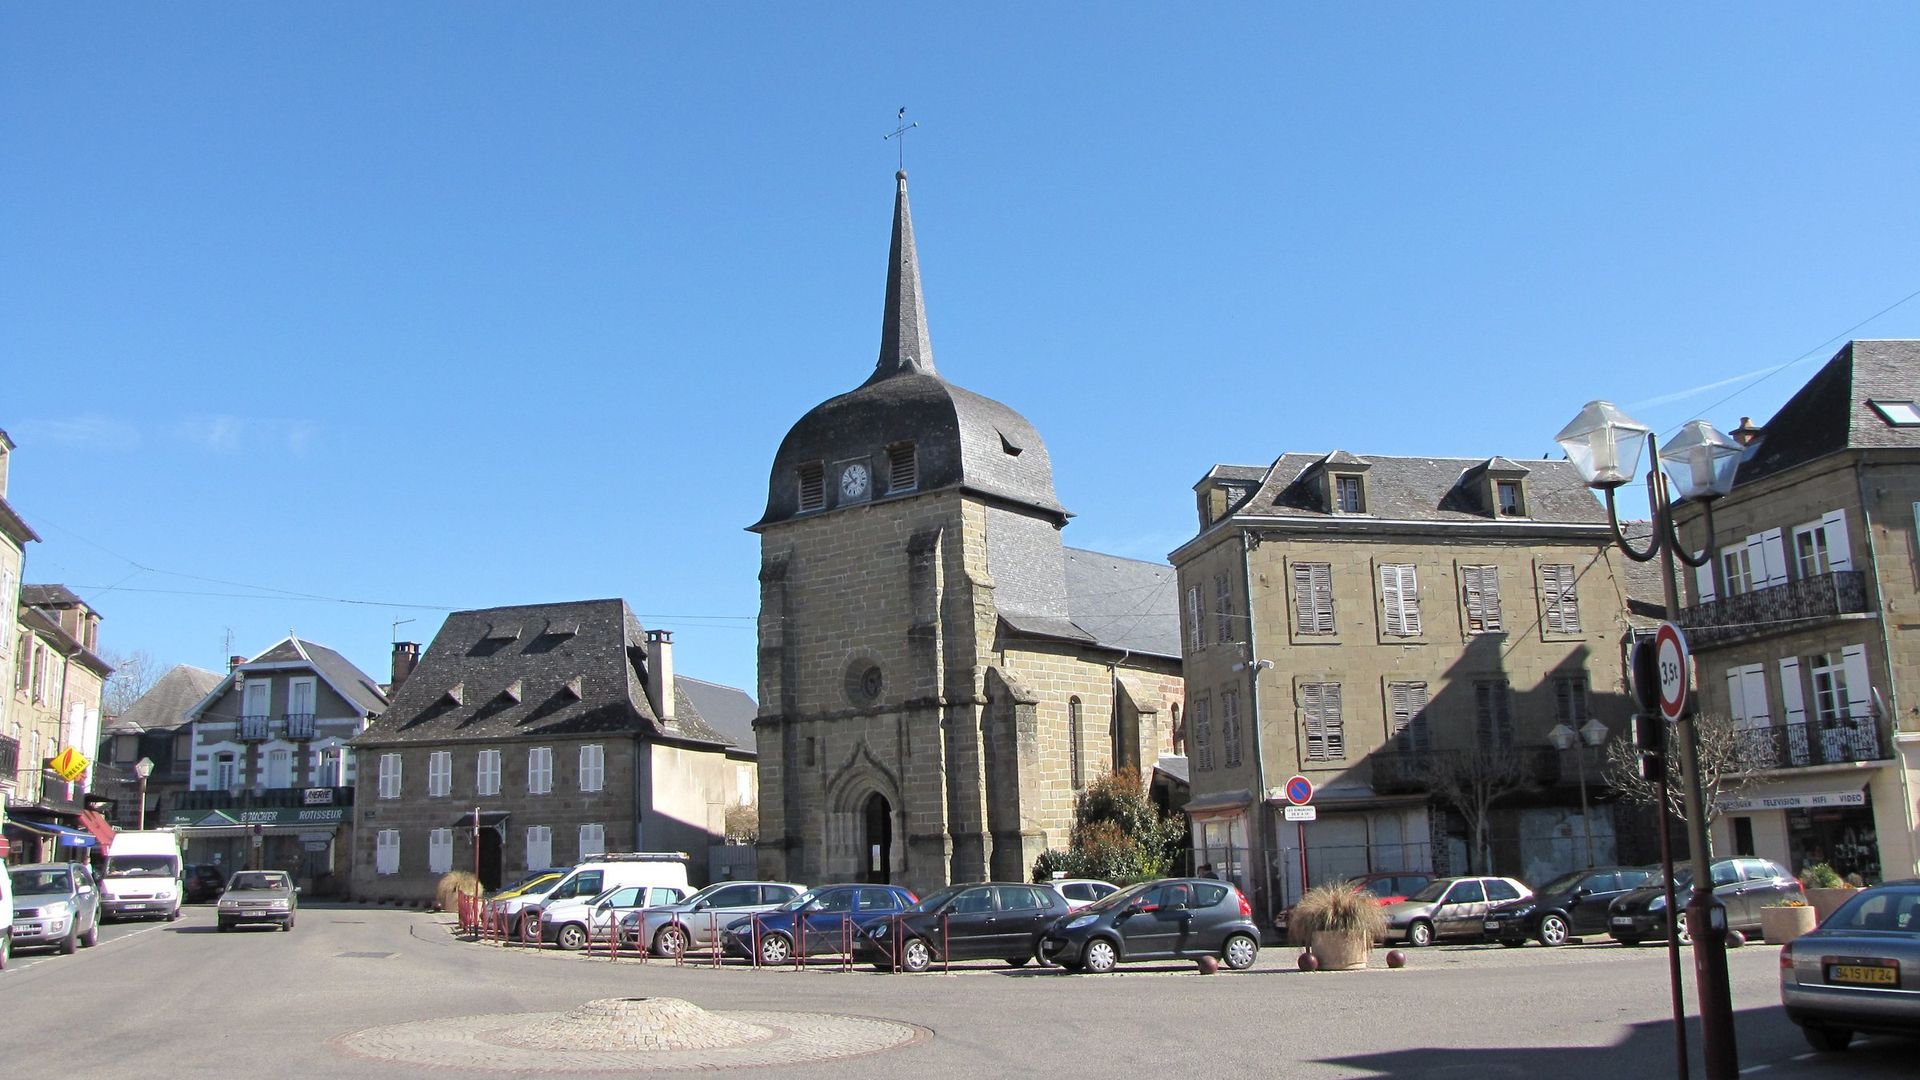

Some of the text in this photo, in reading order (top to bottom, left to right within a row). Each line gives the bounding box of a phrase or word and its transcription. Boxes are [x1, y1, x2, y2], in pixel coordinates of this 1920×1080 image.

[1661, 662, 1678, 686] 3,5t
[65, 760, 87, 778] PRESSE
[1762, 798, 1800, 807] TELEVISION
[1812, 796, 1827, 804] HIFI
[1839, 794, 1862, 802] VIDEO
[241, 810, 342, 821] BOUCHER ROTISSEUR
[1879, 969, 1892, 981] 24
